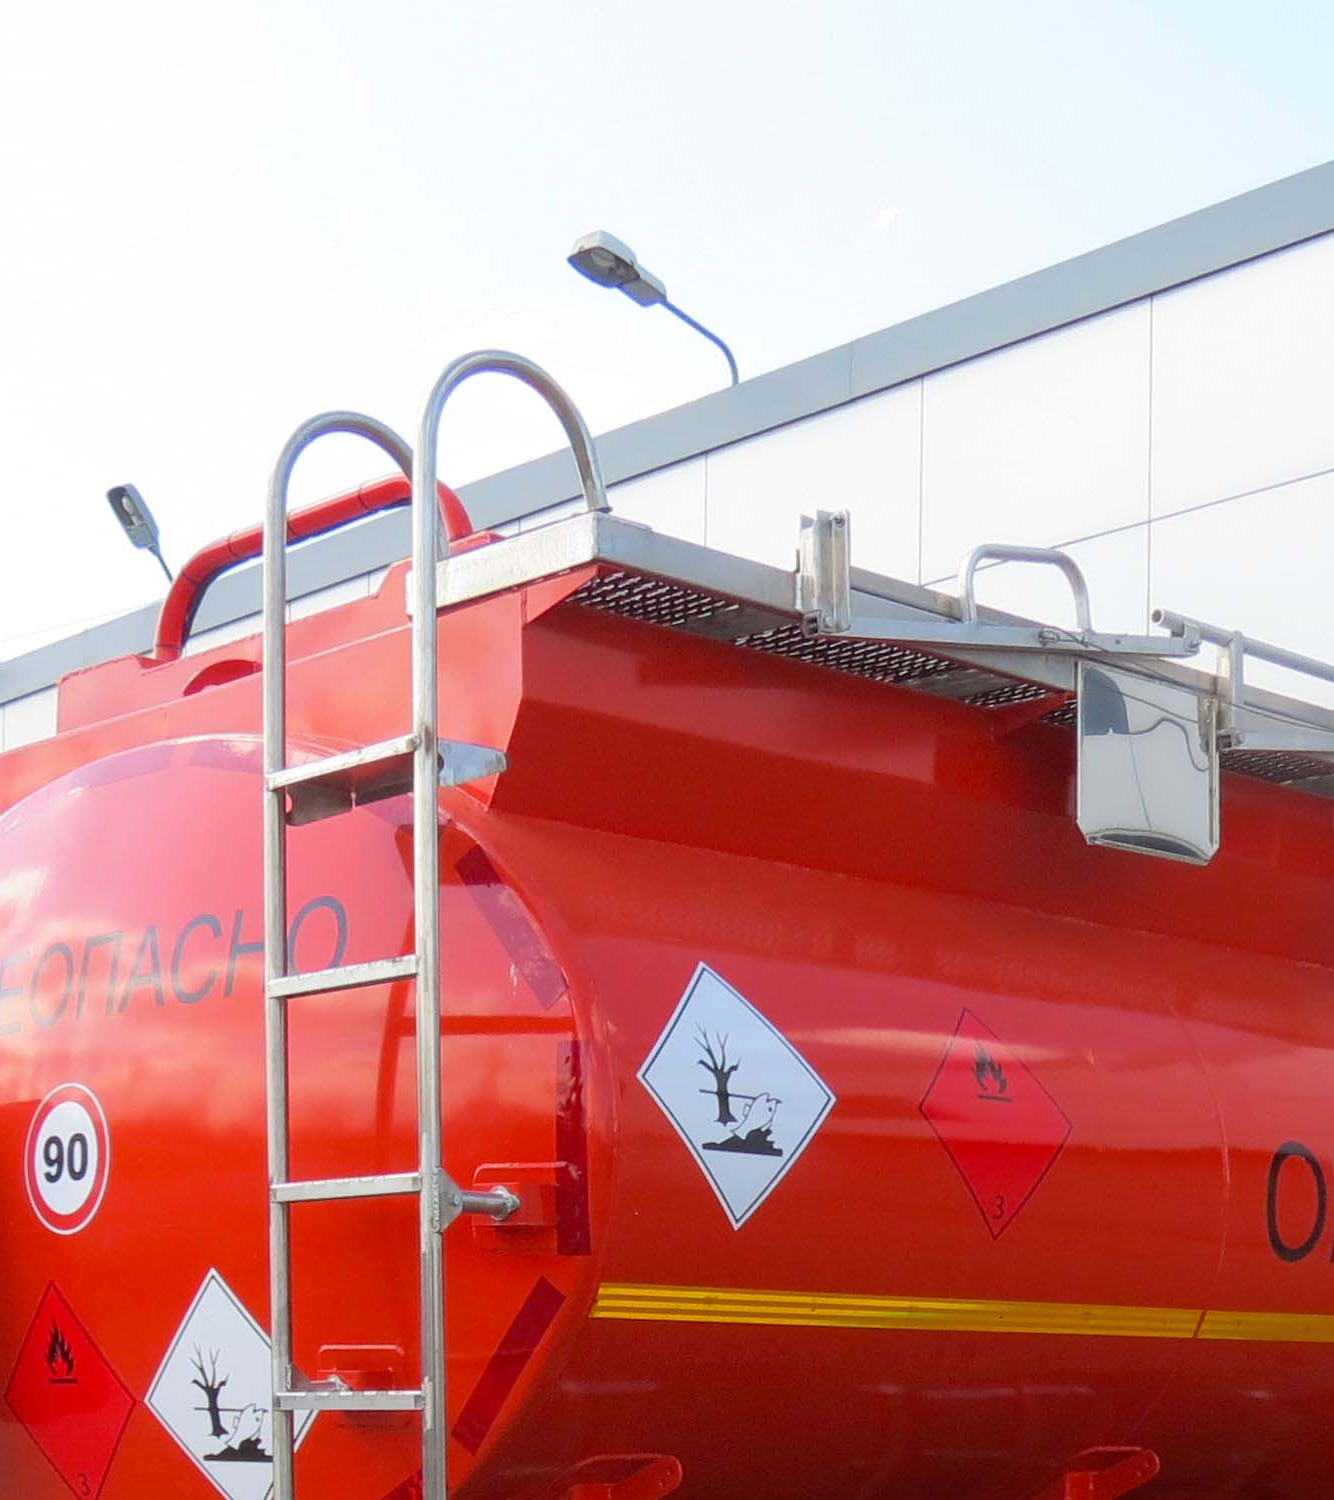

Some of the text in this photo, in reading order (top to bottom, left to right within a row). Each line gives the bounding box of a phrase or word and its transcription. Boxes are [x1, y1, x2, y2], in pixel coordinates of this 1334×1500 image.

[43, 1132, 88, 1184] 90
[994, 1193, 1005, 1220] 3
[77, 1472, 91, 1497] 3
